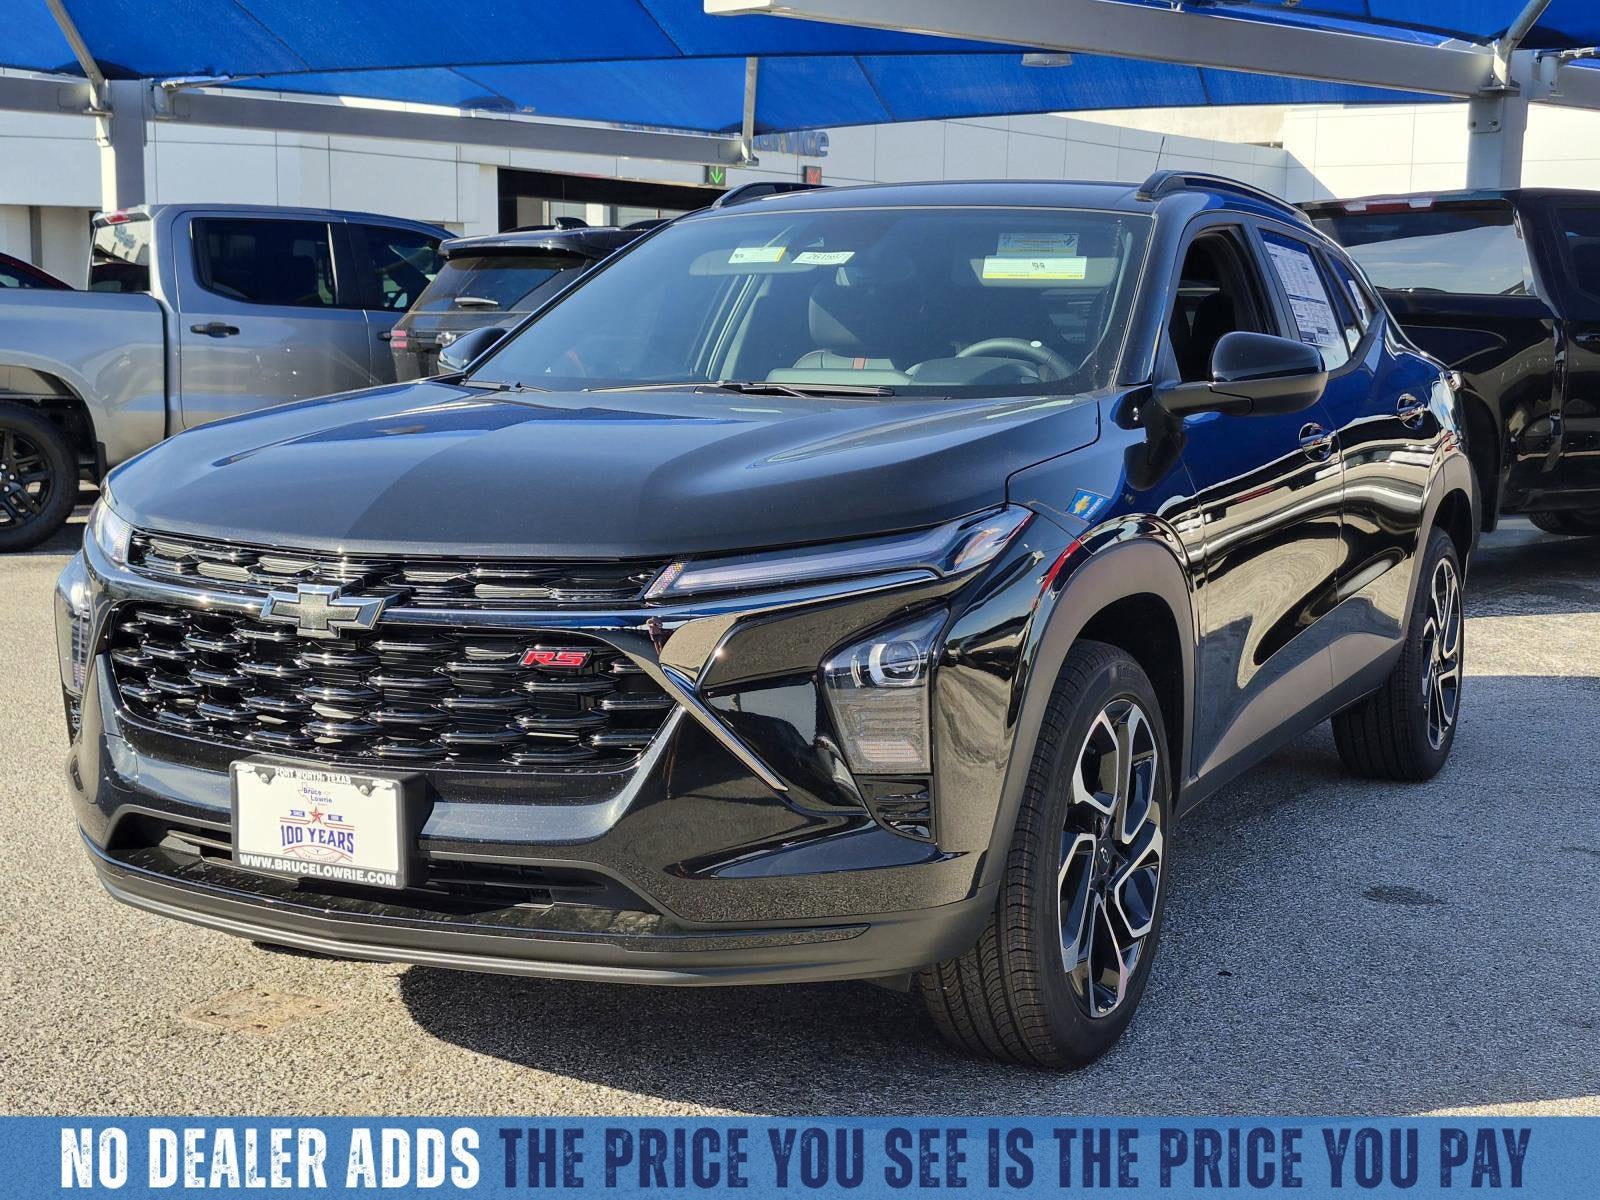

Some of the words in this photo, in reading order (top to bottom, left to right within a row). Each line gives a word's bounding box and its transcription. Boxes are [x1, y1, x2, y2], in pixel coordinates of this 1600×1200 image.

[521, 650, 589, 667] RS
[275, 767, 296, 778] FORT
[326, 773, 352, 784] TEXAS
[303, 787, 322, 796] Bruce
[280, 824, 303, 847] 100
[307, 827, 355, 855] YEARS
[239, 853, 397, 886] WWW.BRUCELOWRIE.COM
